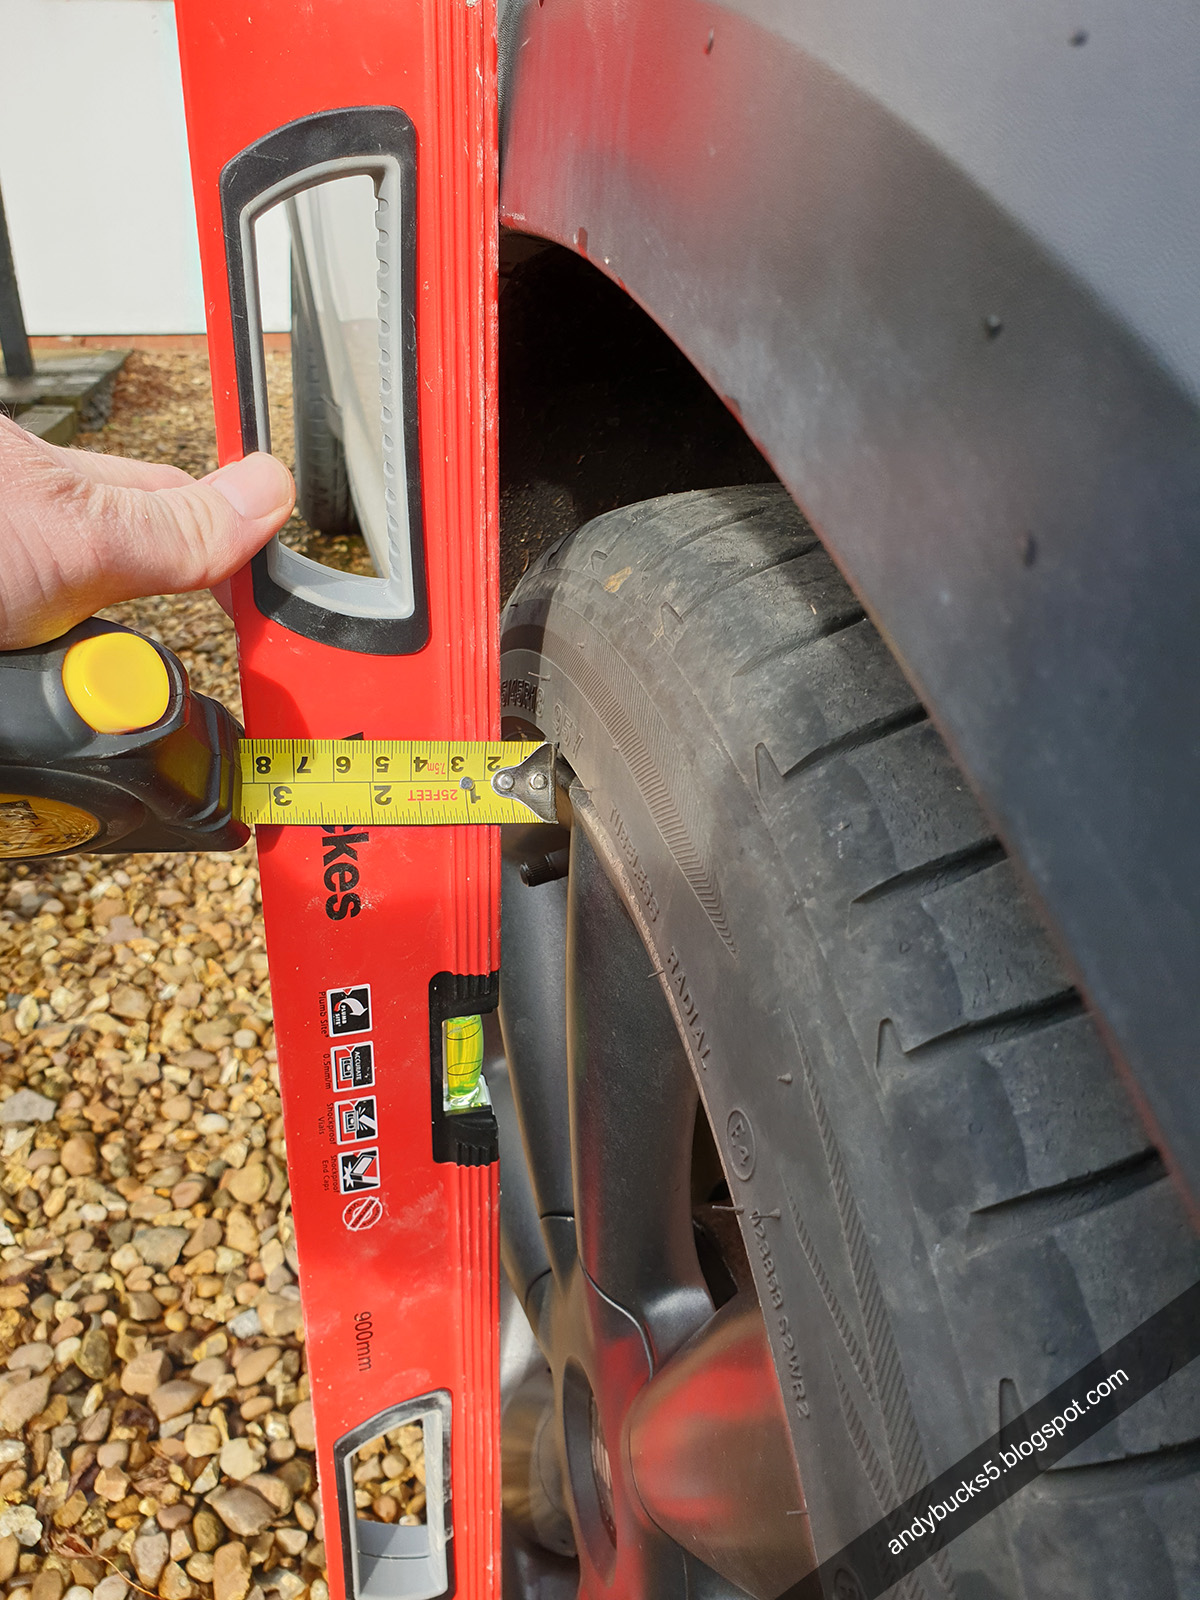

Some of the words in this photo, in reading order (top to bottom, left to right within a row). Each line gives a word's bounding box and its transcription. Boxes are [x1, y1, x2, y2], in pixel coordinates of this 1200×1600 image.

[255, 756, 272, 775] 8
[296, 756, 312, 774] 7
[335, 756, 351, 774] 6
[375, 756, 391, 773] 5
[413, 756, 428, 773] 4
[427, 762, 446, 775] 7.5m
[451, 756, 465, 773] 3
[487, 756, 501, 772] 2
[273, 785, 292, 807] 3
[374, 785, 392, 806] 2
[408, 789, 458, 802] 25FEET
[469, 785, 481, 804] 1
[318, 991, 327, 1017] Plumb
[667, 945, 711, 1070] RADIAL
[322, 1053, 332, 1090] 0.5mm/m
[354, 1051, 363, 1081] ACCURATE
[326, 1102, 337, 1145] Shockproof
[321, 1159, 330, 1174] End
[330, 1154, 341, 1193] Shockproof
[322, 1175, 330, 1192] Caps
[354, 1311, 373, 1371] 900mm
